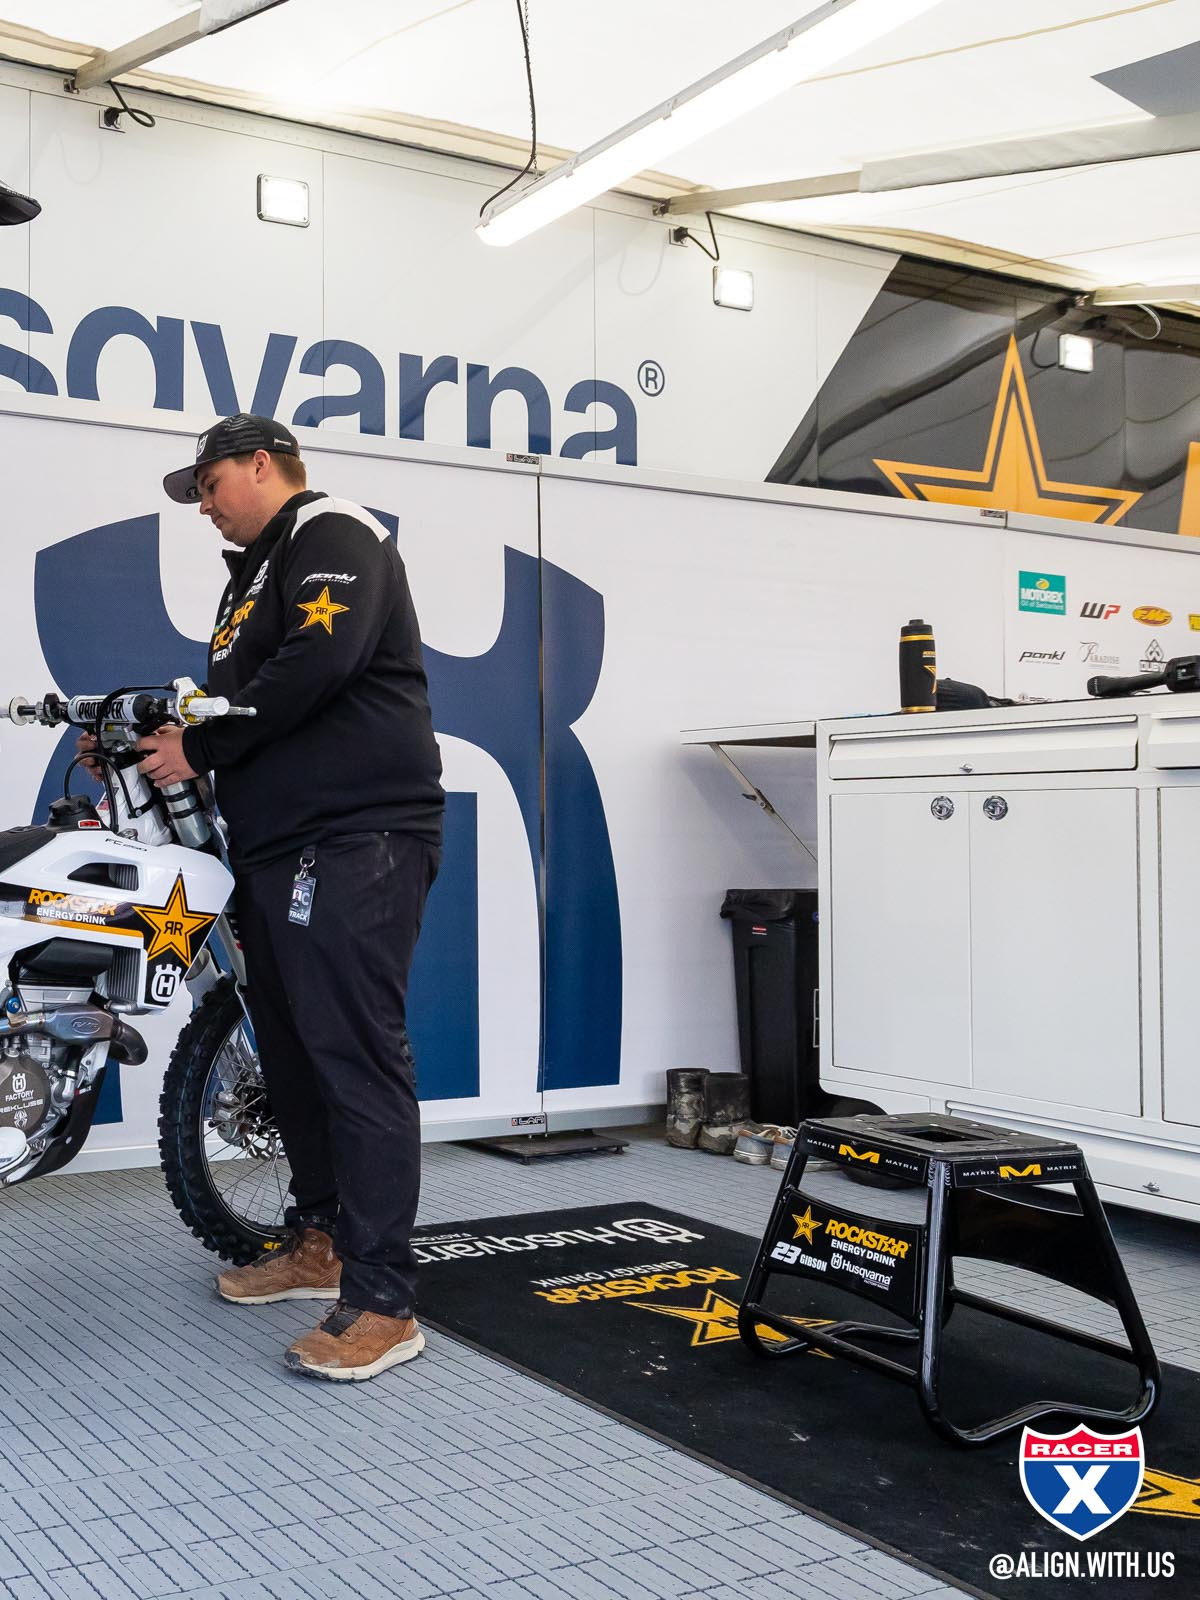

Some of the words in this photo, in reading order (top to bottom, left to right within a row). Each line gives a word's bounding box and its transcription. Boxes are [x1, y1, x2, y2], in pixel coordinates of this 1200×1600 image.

[1021, 588, 1064, 603] MOTOREX
[1080, 601, 1121, 620] WP
[1019, 651, 1066, 662] pankl
[36, 906, 79, 922] ENERGY
[75, 912, 107, 926] DRINK
[289, 910, 308, 921] TRACK
[5, 1089, 34, 1102] FACTORY
[807, 1138, 836, 1151] MATRIX
[885, 1158, 919, 1172] MATRIX
[412, 1226, 617, 1264] Husqvarn
[825, 1218, 909, 1259] ROCKSTAR
[770, 1241, 802, 1265] 23
[800, 1253, 828, 1272] GIBSON
[831, 1238, 868, 1257] ENERGY
[866, 1250, 897, 1268] DRINK
[530, 1271, 601, 1288] DRINK
[603, 1261, 689, 1279] ENERGY
[841, 1259, 891, 1286] Husqvarna
[534, 1266, 742, 1305] ROCKSTAR
